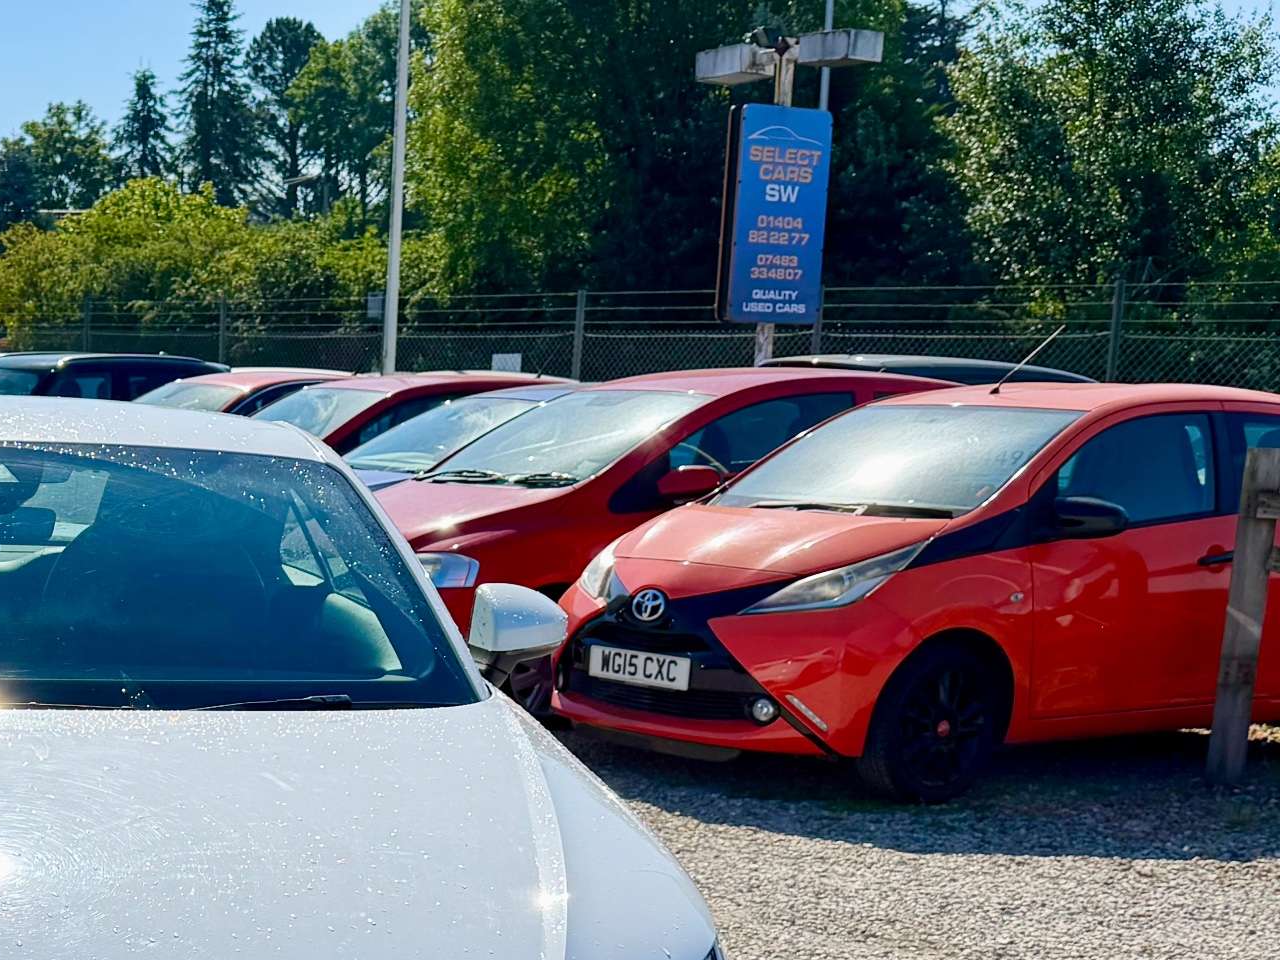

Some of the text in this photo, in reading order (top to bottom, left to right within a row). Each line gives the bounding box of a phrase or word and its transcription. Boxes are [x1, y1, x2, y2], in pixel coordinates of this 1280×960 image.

[749, 145, 822, 167] SELECT
[759, 164, 814, 184] CARS
[765, 183, 800, 203] SW
[757, 215, 803, 229] 01404
[757, 254, 798, 267] 07483
[750, 267, 803, 280] 334807
[752, 289, 798, 301] QUALITY
[742, 302, 806, 314] USED CARS
[601, 650, 678, 682] WG15 CXC
